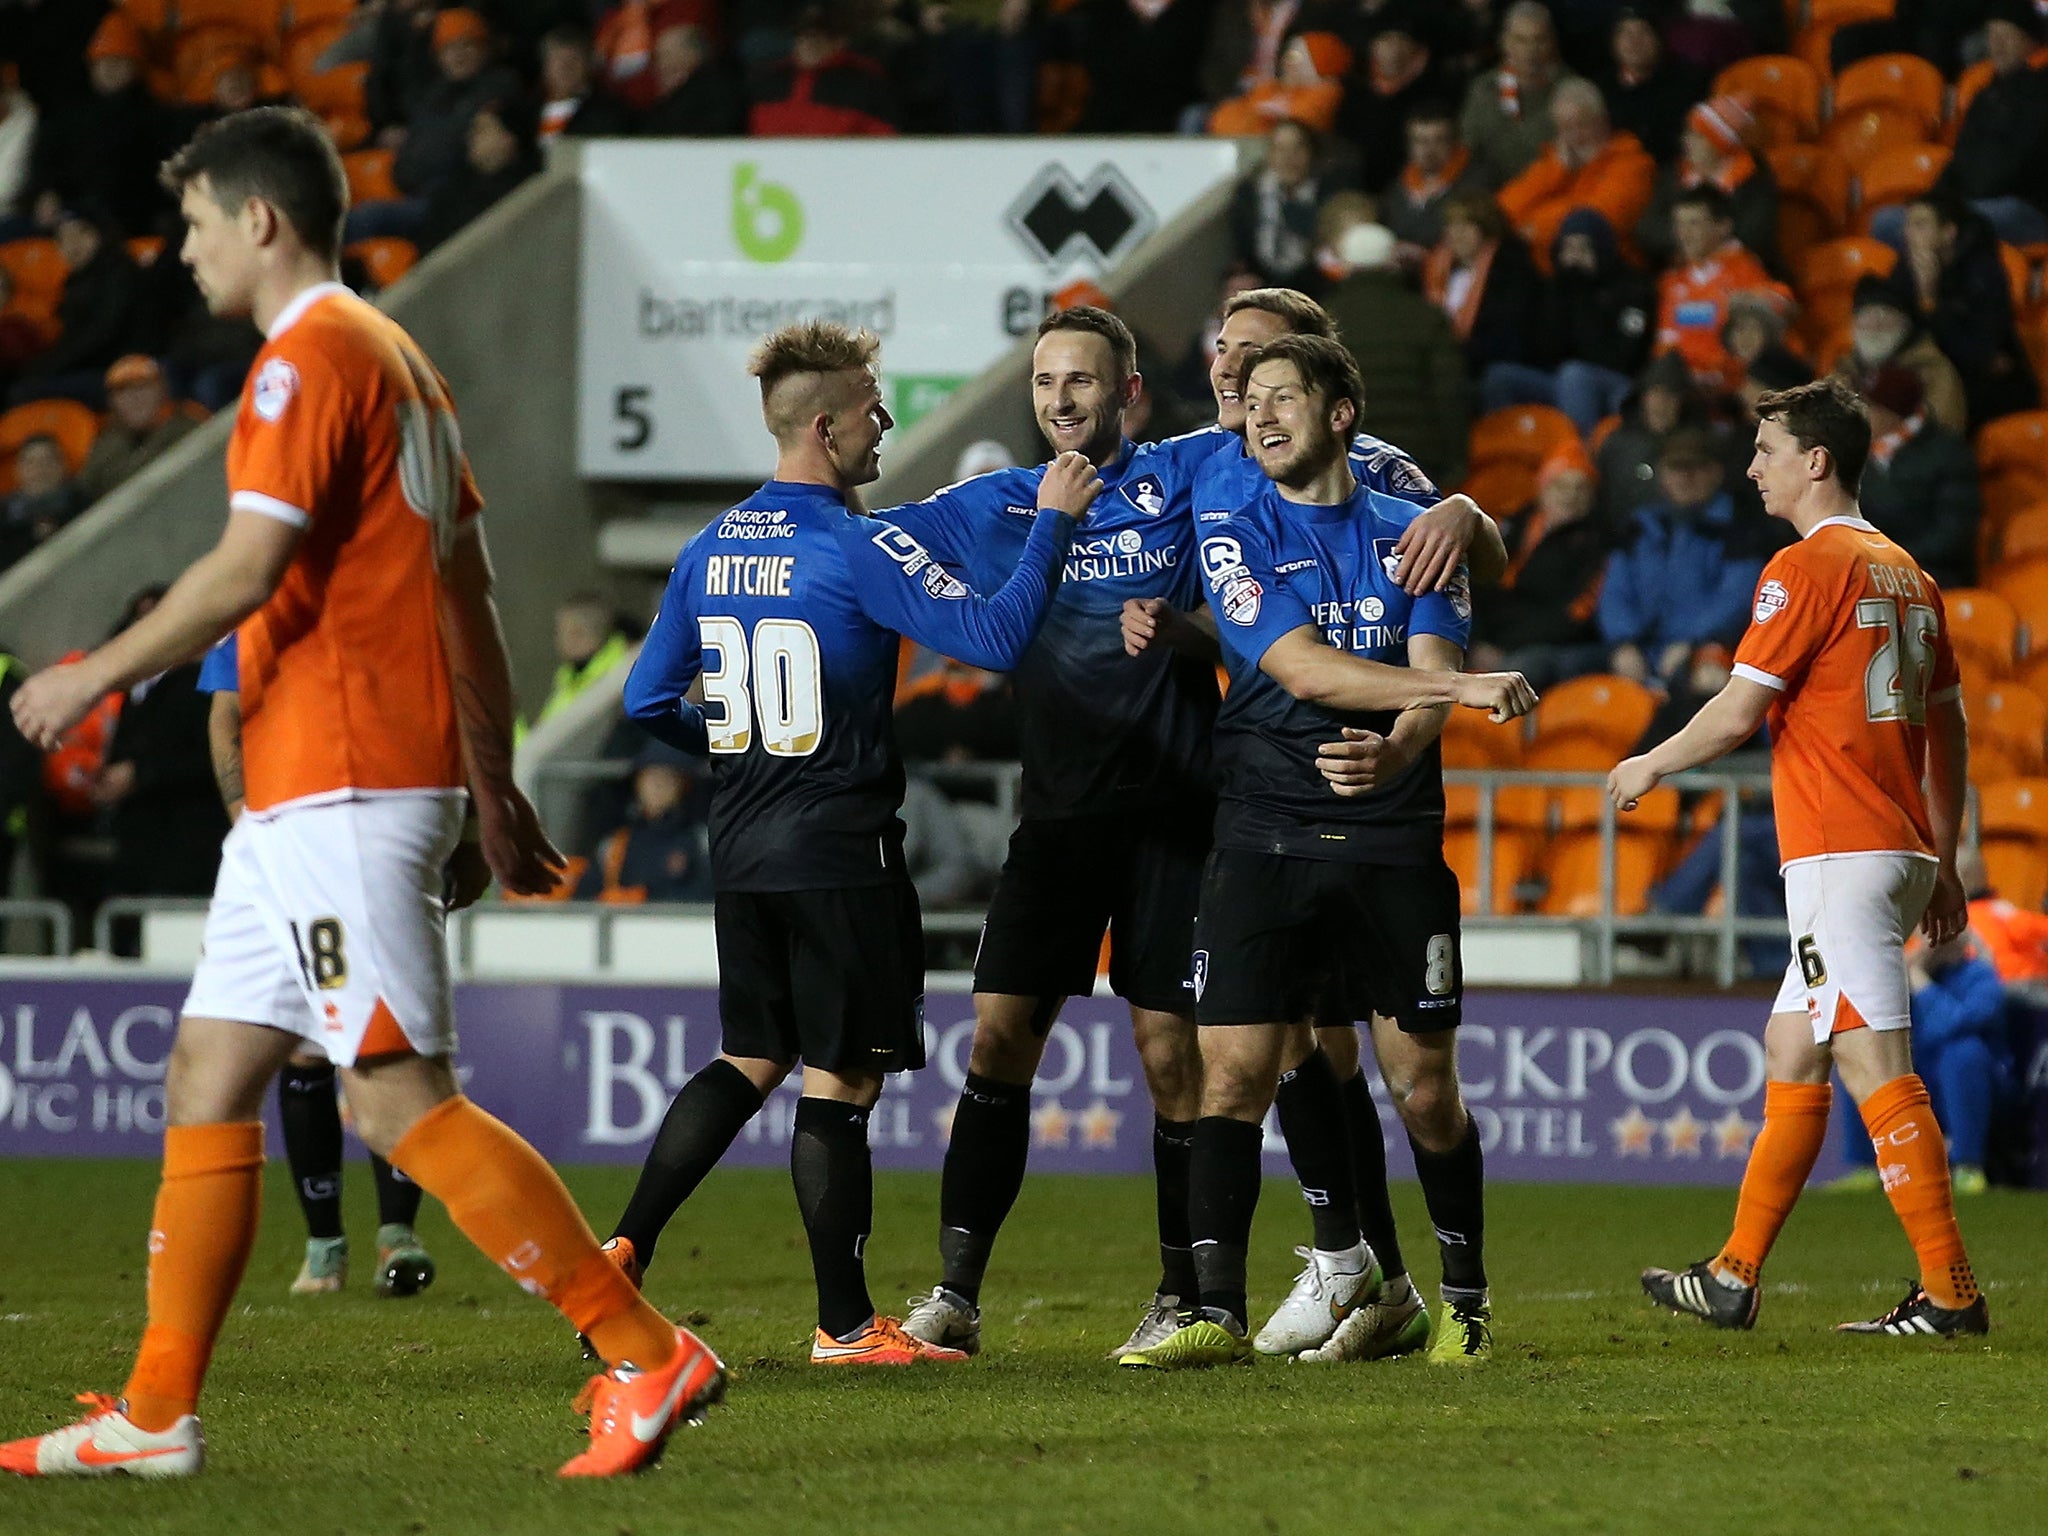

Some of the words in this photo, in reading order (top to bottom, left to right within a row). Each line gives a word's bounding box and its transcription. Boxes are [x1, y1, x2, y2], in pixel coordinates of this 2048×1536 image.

[615, 385, 653, 452] 5
[717, 522, 797, 539] CONSULTING
[724, 510, 775, 525] ENERGY
[706, 555, 796, 597] RITCHIE
[1062, 545, 1177, 583] NSULTING
[1868, 563, 1922, 598] FOLEY
[1236, 584, 1260, 604] BET
[1856, 598, 1939, 727] 26
[697, 616, 823, 757] 30
[1425, 934, 1454, 996] 8
[1456, 1024, 1767, 1104] CKPOO
